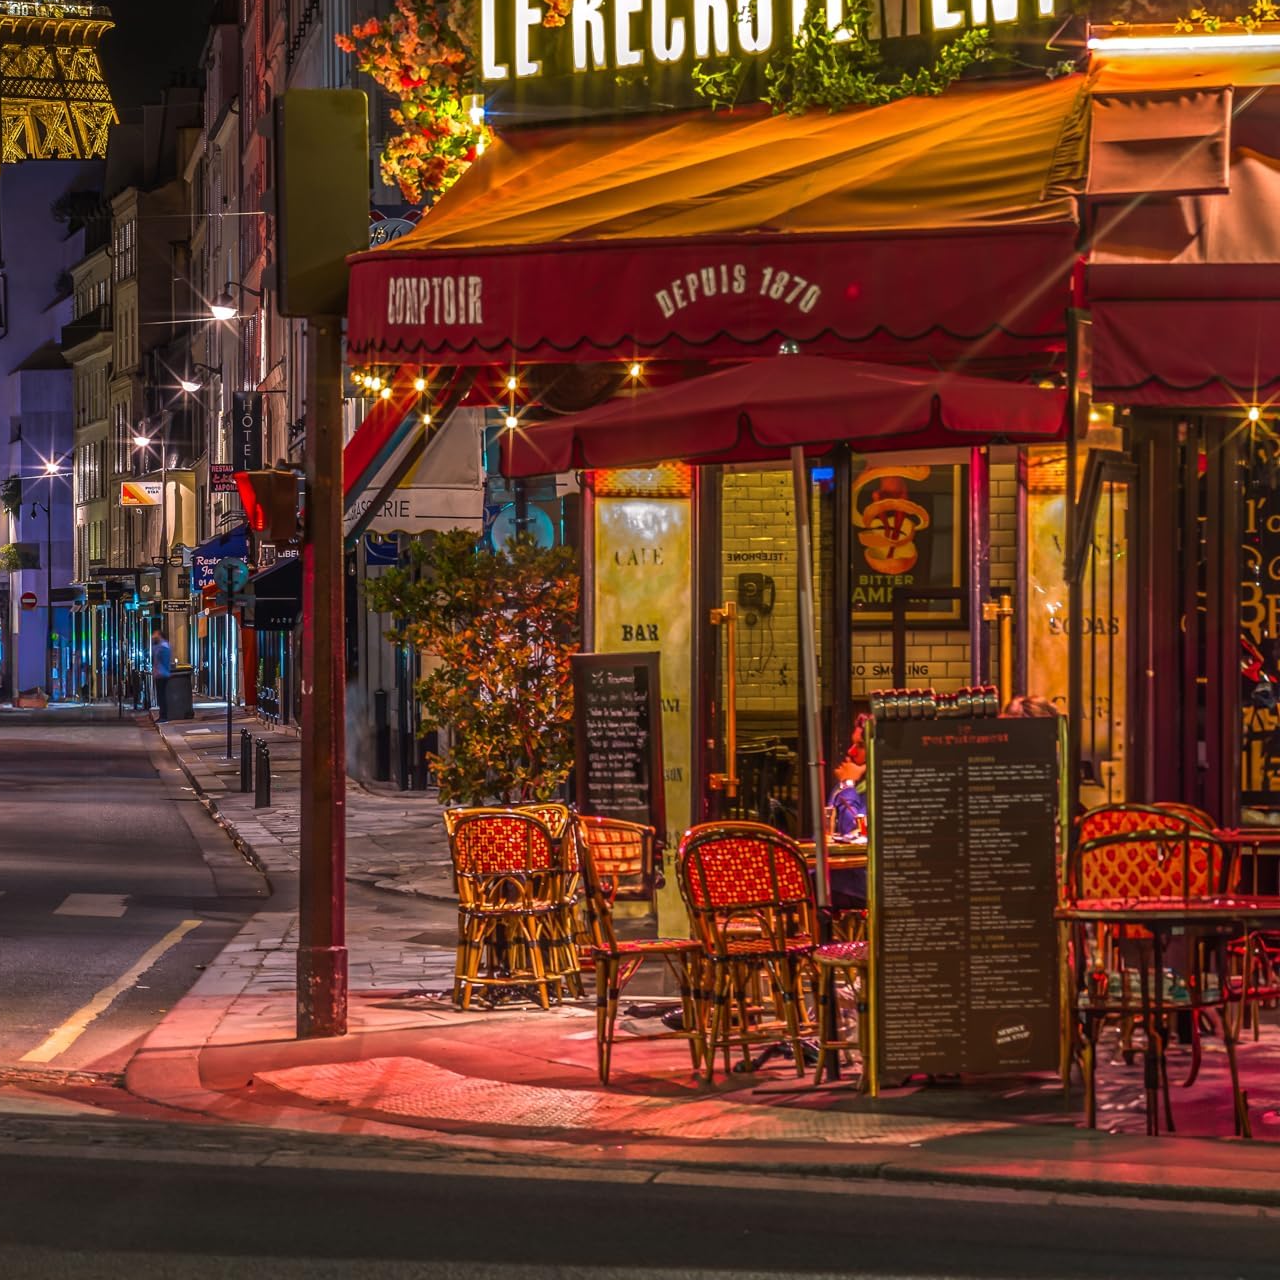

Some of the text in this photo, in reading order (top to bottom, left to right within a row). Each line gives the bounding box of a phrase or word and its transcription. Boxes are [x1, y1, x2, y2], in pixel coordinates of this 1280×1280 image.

[388, 276, 484, 325] COMPTOIR
[655, 264, 822, 318] DEPUIS 1870
[242, 399, 254, 471] HÔTEL
[859, 575, 914, 585] BITTER
[621, 624, 659, 642] BAR
[873, 665, 928, 676] SMING
